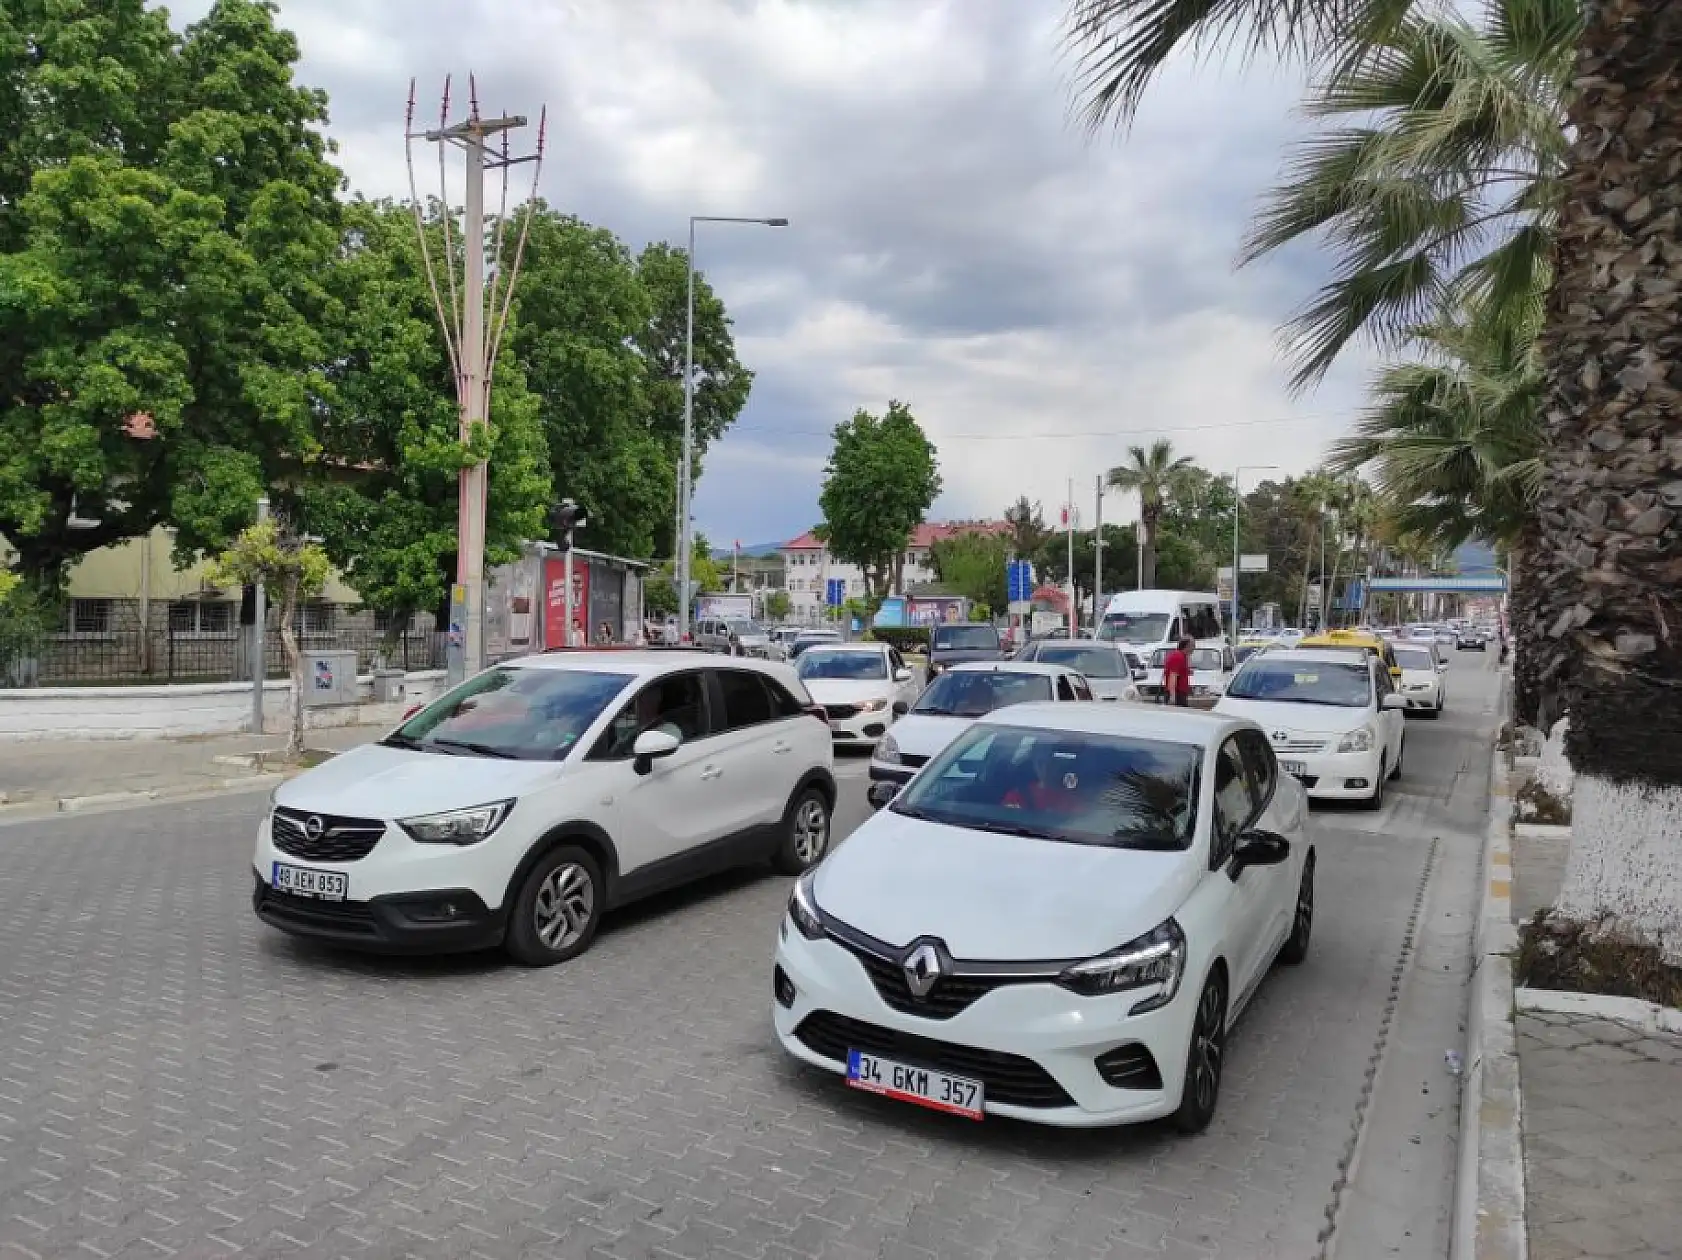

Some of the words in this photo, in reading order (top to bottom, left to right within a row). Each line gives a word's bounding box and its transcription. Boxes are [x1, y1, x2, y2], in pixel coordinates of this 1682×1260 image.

[861, 1057, 881, 1083] 34
[893, 1066, 928, 1095] GKM
[940, 1078, 978, 1107] 357
